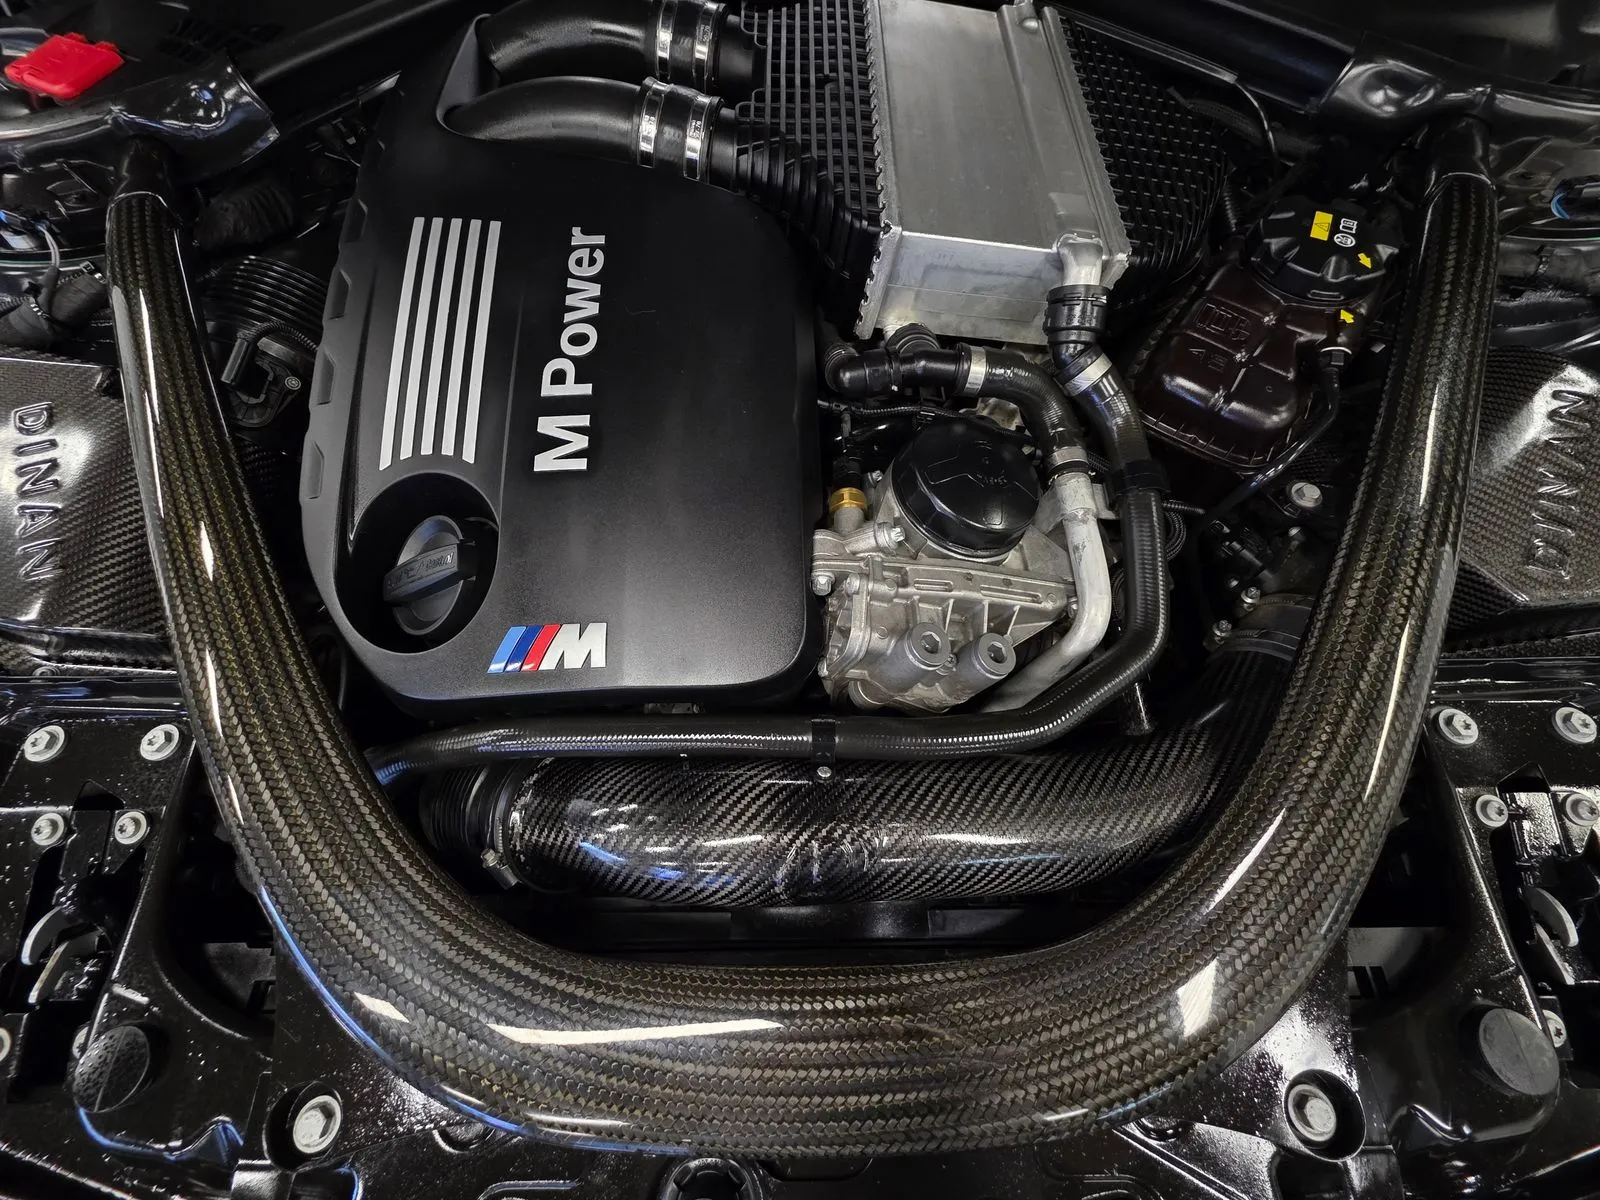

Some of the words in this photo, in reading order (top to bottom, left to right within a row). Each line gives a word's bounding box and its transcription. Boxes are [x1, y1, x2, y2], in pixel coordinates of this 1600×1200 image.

[540, 226, 606, 397] Power
[11, 401, 63, 582] DINAN
[533, 414, 591, 472] M
[1525, 388, 1597, 579] DINAN
[537, 622, 607, 671] M
